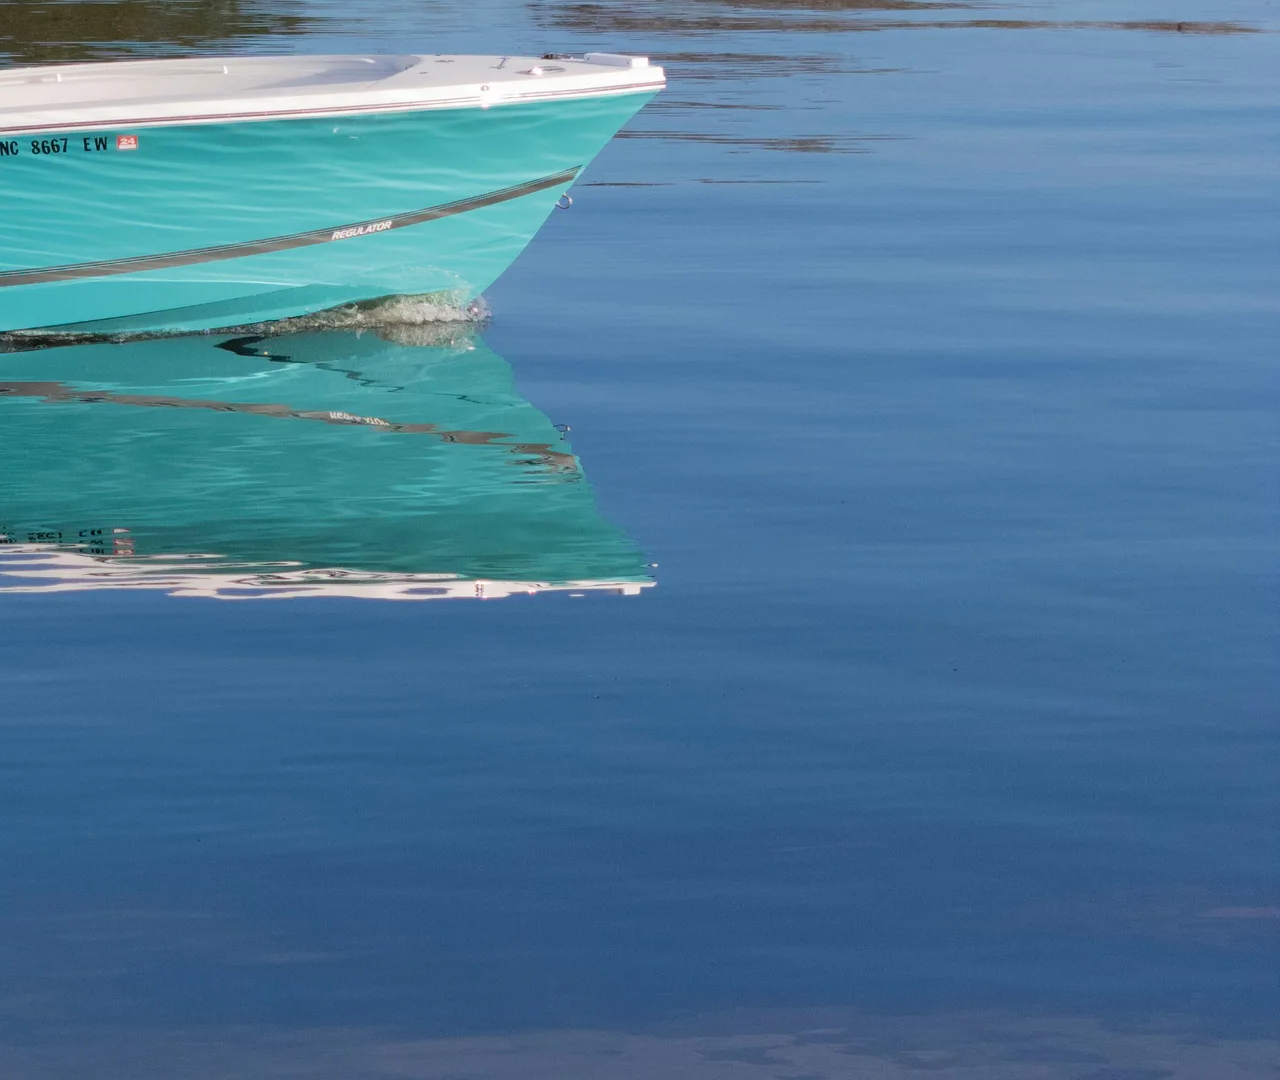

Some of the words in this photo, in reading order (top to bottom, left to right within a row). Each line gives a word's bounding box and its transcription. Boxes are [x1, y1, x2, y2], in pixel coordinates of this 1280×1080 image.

[31, 137, 68, 155] 8667
[83, 136, 108, 152] EW
[331, 220, 393, 241] REGULATOR
